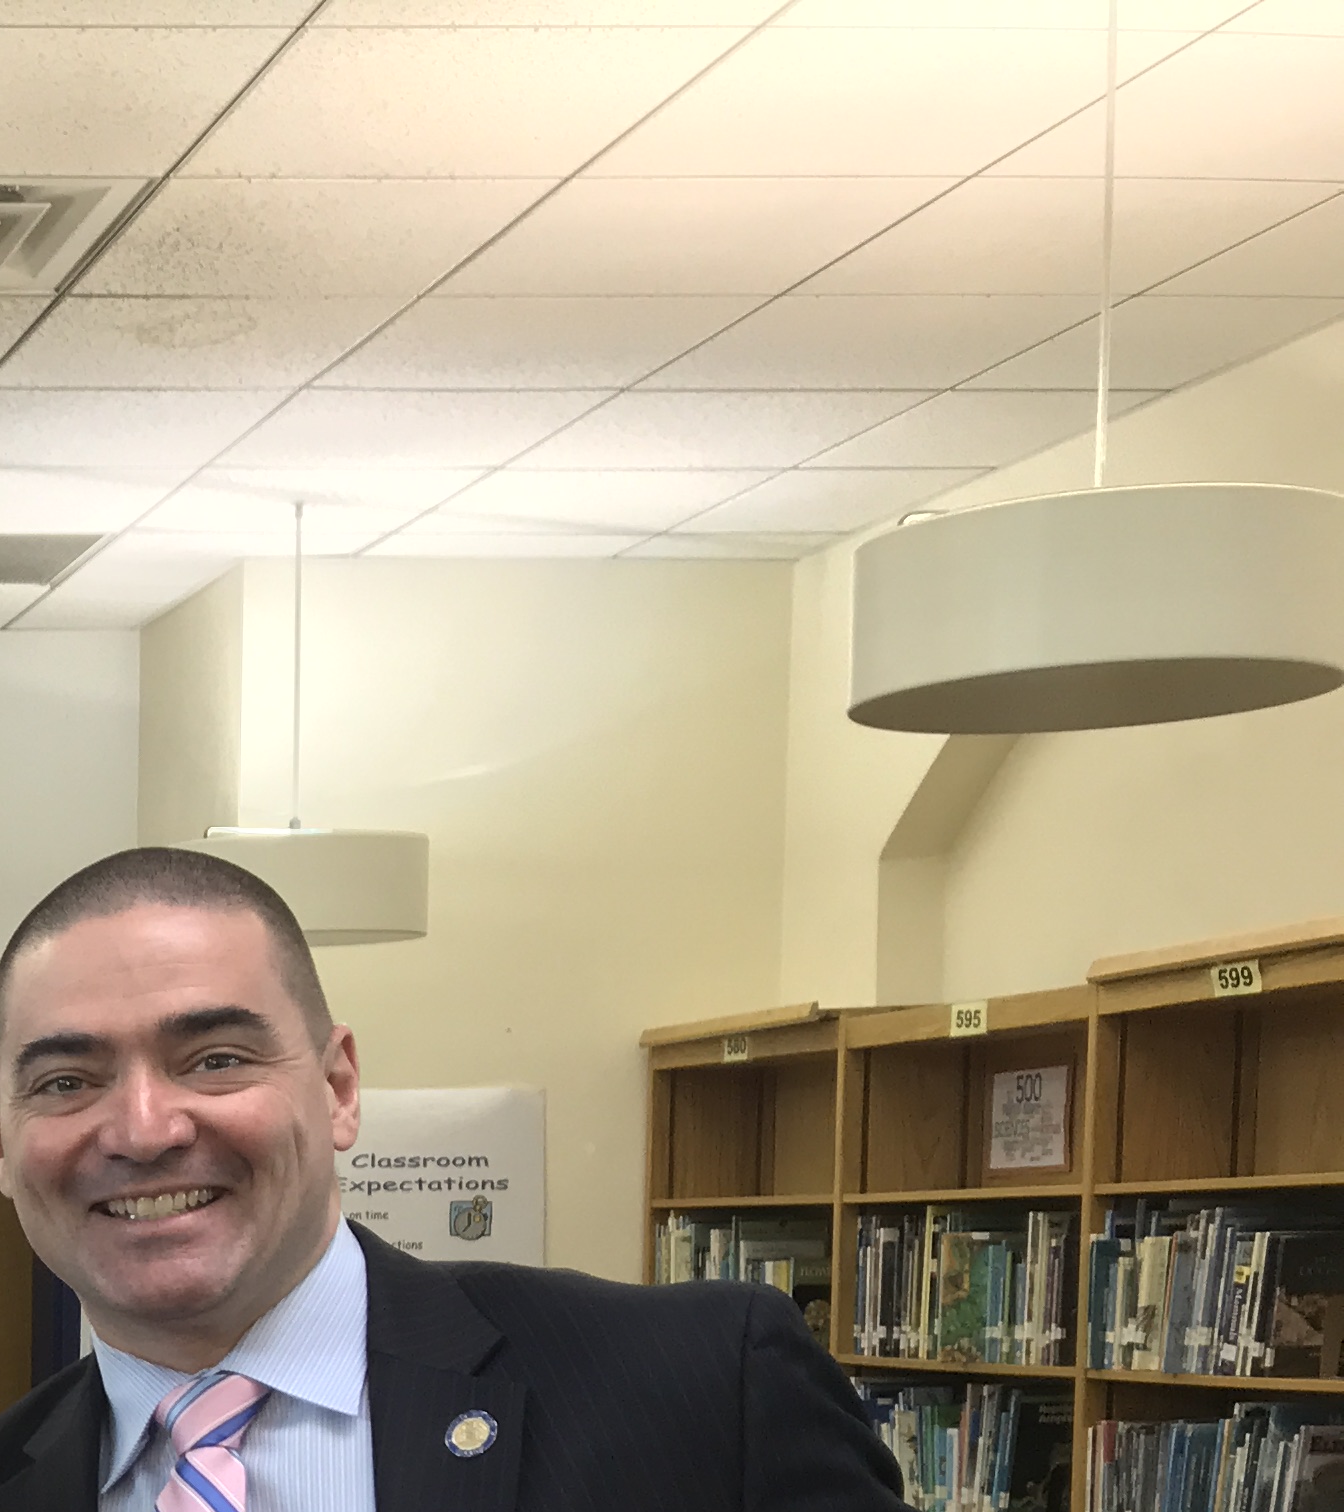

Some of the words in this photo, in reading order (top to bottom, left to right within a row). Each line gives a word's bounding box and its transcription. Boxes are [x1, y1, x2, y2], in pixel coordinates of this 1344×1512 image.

[1218, 966, 1253, 989] 599
[956, 1009, 982, 1028] 595
[1015, 1072, 1042, 1103] 500
[352, 1153, 489, 1169] Classroom
[339, 1175, 509, 1196] Expectations
[349, 1212, 362, 1220] on
[366, 1211, 389, 1220] time
